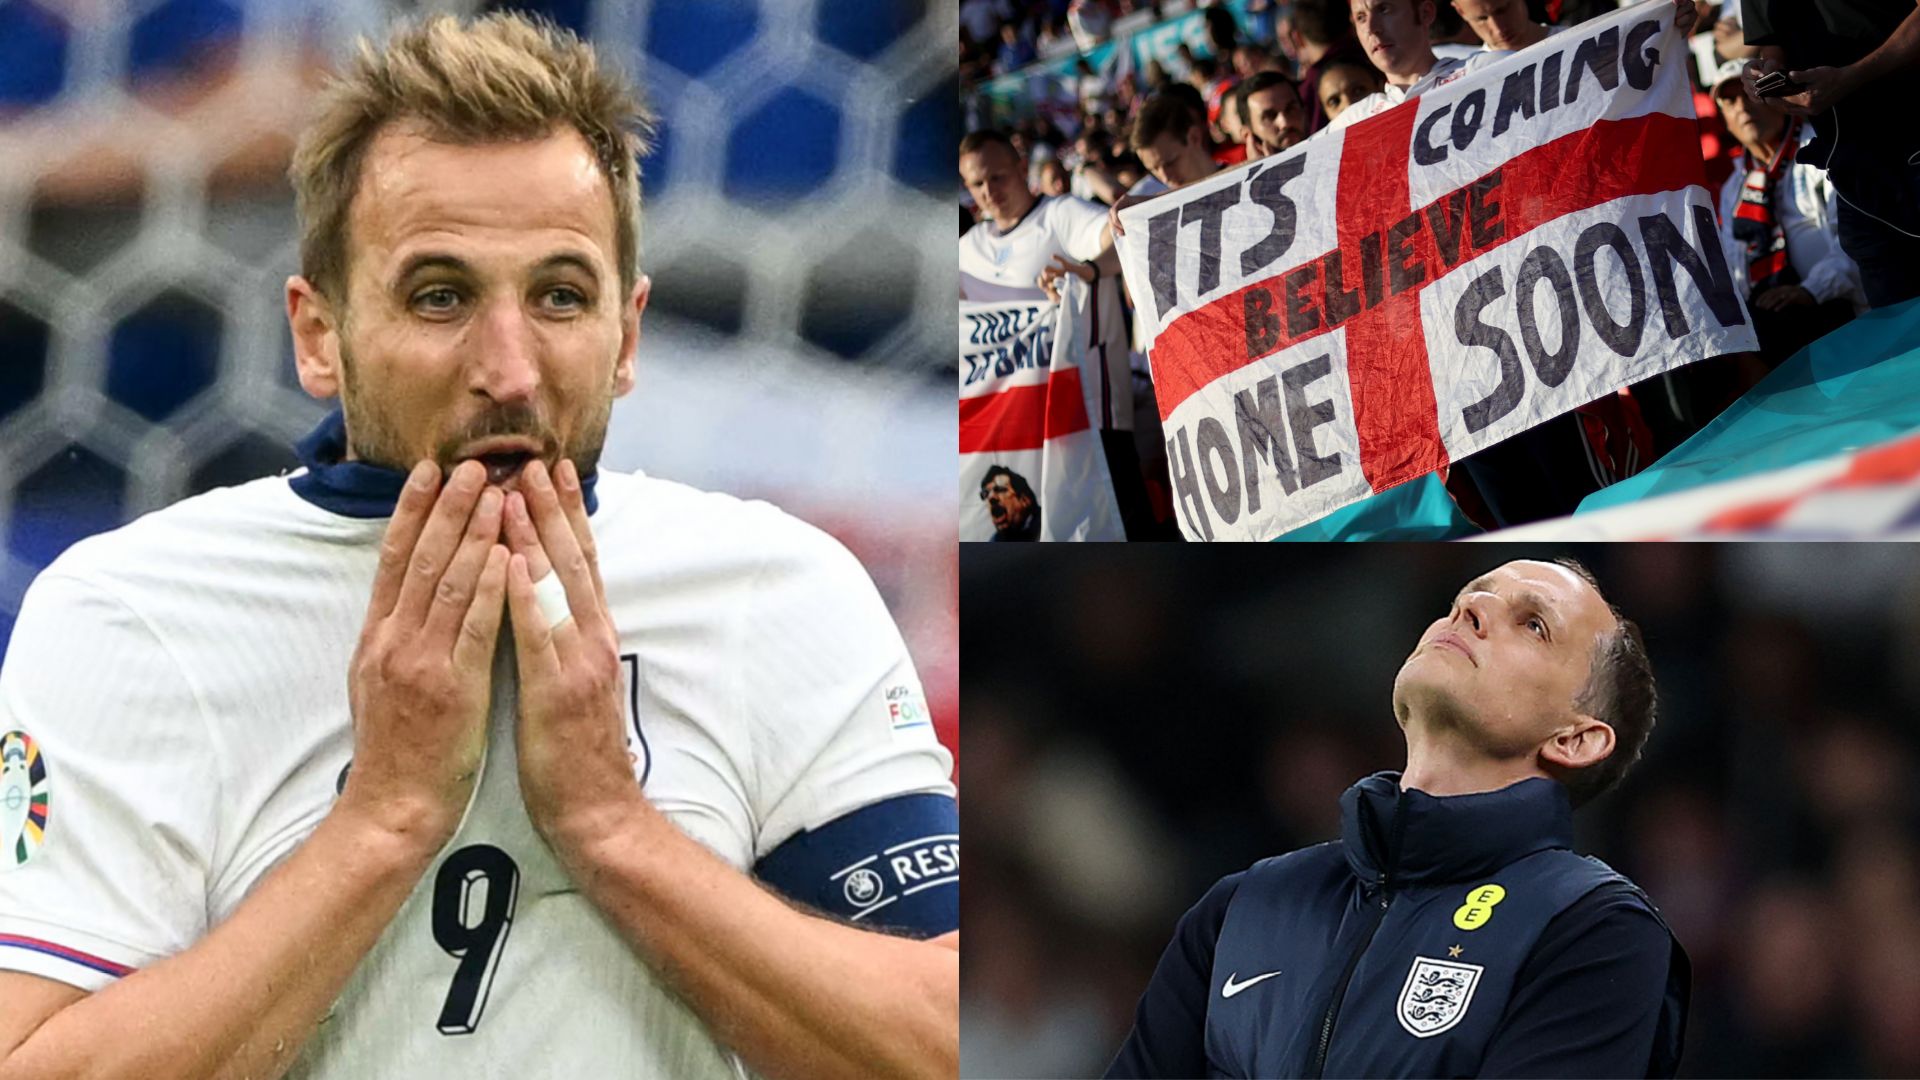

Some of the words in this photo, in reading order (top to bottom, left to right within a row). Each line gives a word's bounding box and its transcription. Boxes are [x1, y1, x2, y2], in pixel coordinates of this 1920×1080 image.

[1147, 151, 1307, 321] IT'S
[1413, 20, 1661, 166] COMING
[1244, 170, 1505, 359] BELIEVE
[1167, 353, 1342, 541] HOME
[1454, 205, 1745, 434] SOON
[431, 844, 520, 1035] 9
